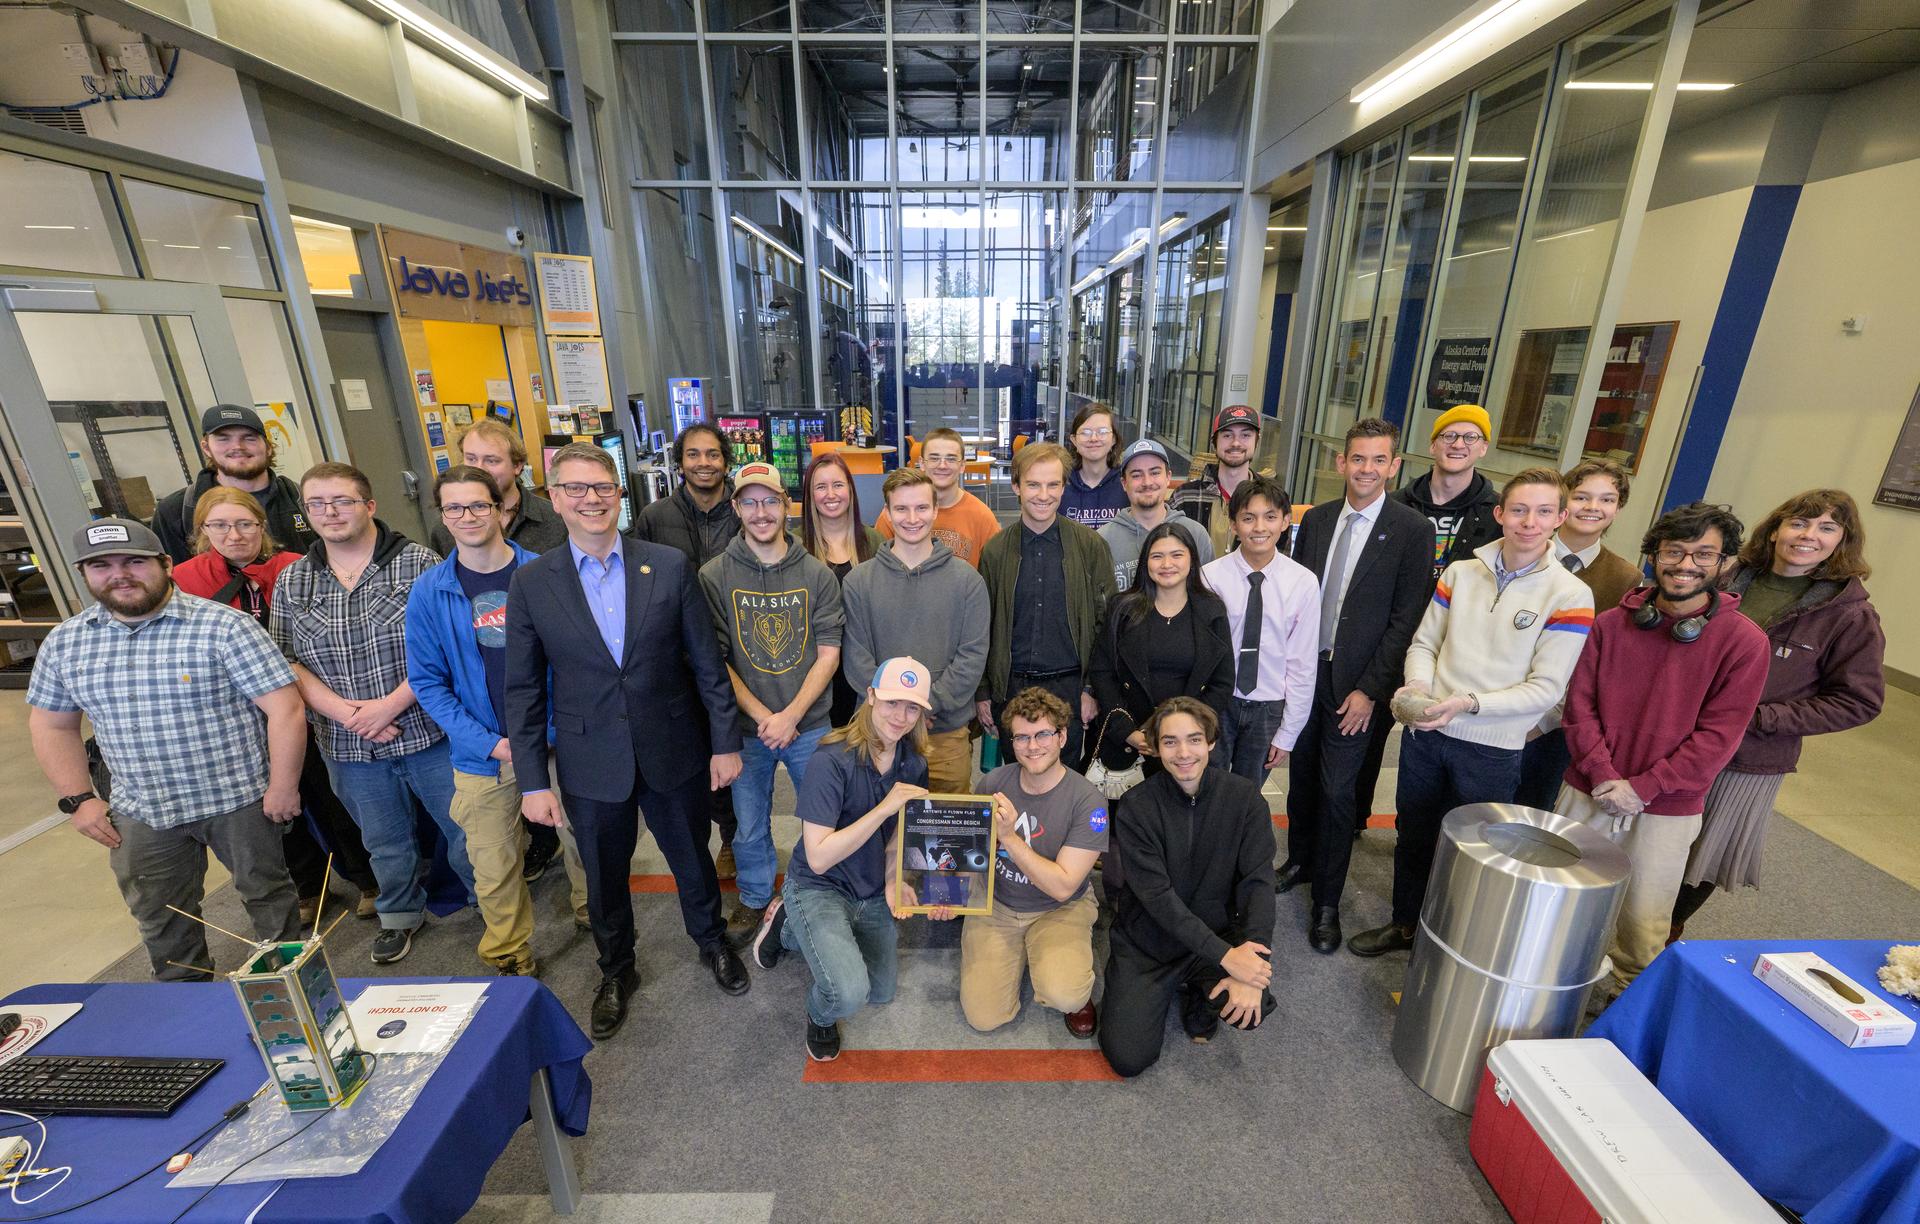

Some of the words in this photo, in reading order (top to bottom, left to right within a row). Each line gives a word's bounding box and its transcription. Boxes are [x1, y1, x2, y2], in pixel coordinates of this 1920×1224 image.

[400, 255, 471, 299] Java
[1445, 345, 1461, 356] Alaska
[1462, 345, 1481, 356] Center
[1481, 344, 1489, 356] fo
[1441, 359, 1460, 373] Energy
[1460, 359, 1472, 371] and
[1445, 380, 1463, 394] Design
[741, 594, 801, 609] ALASKA
[367, 1007, 406, 1015] TOUCH!
[406, 1005, 431, 1014] NOT
[432, 1005, 447, 1013] DO
